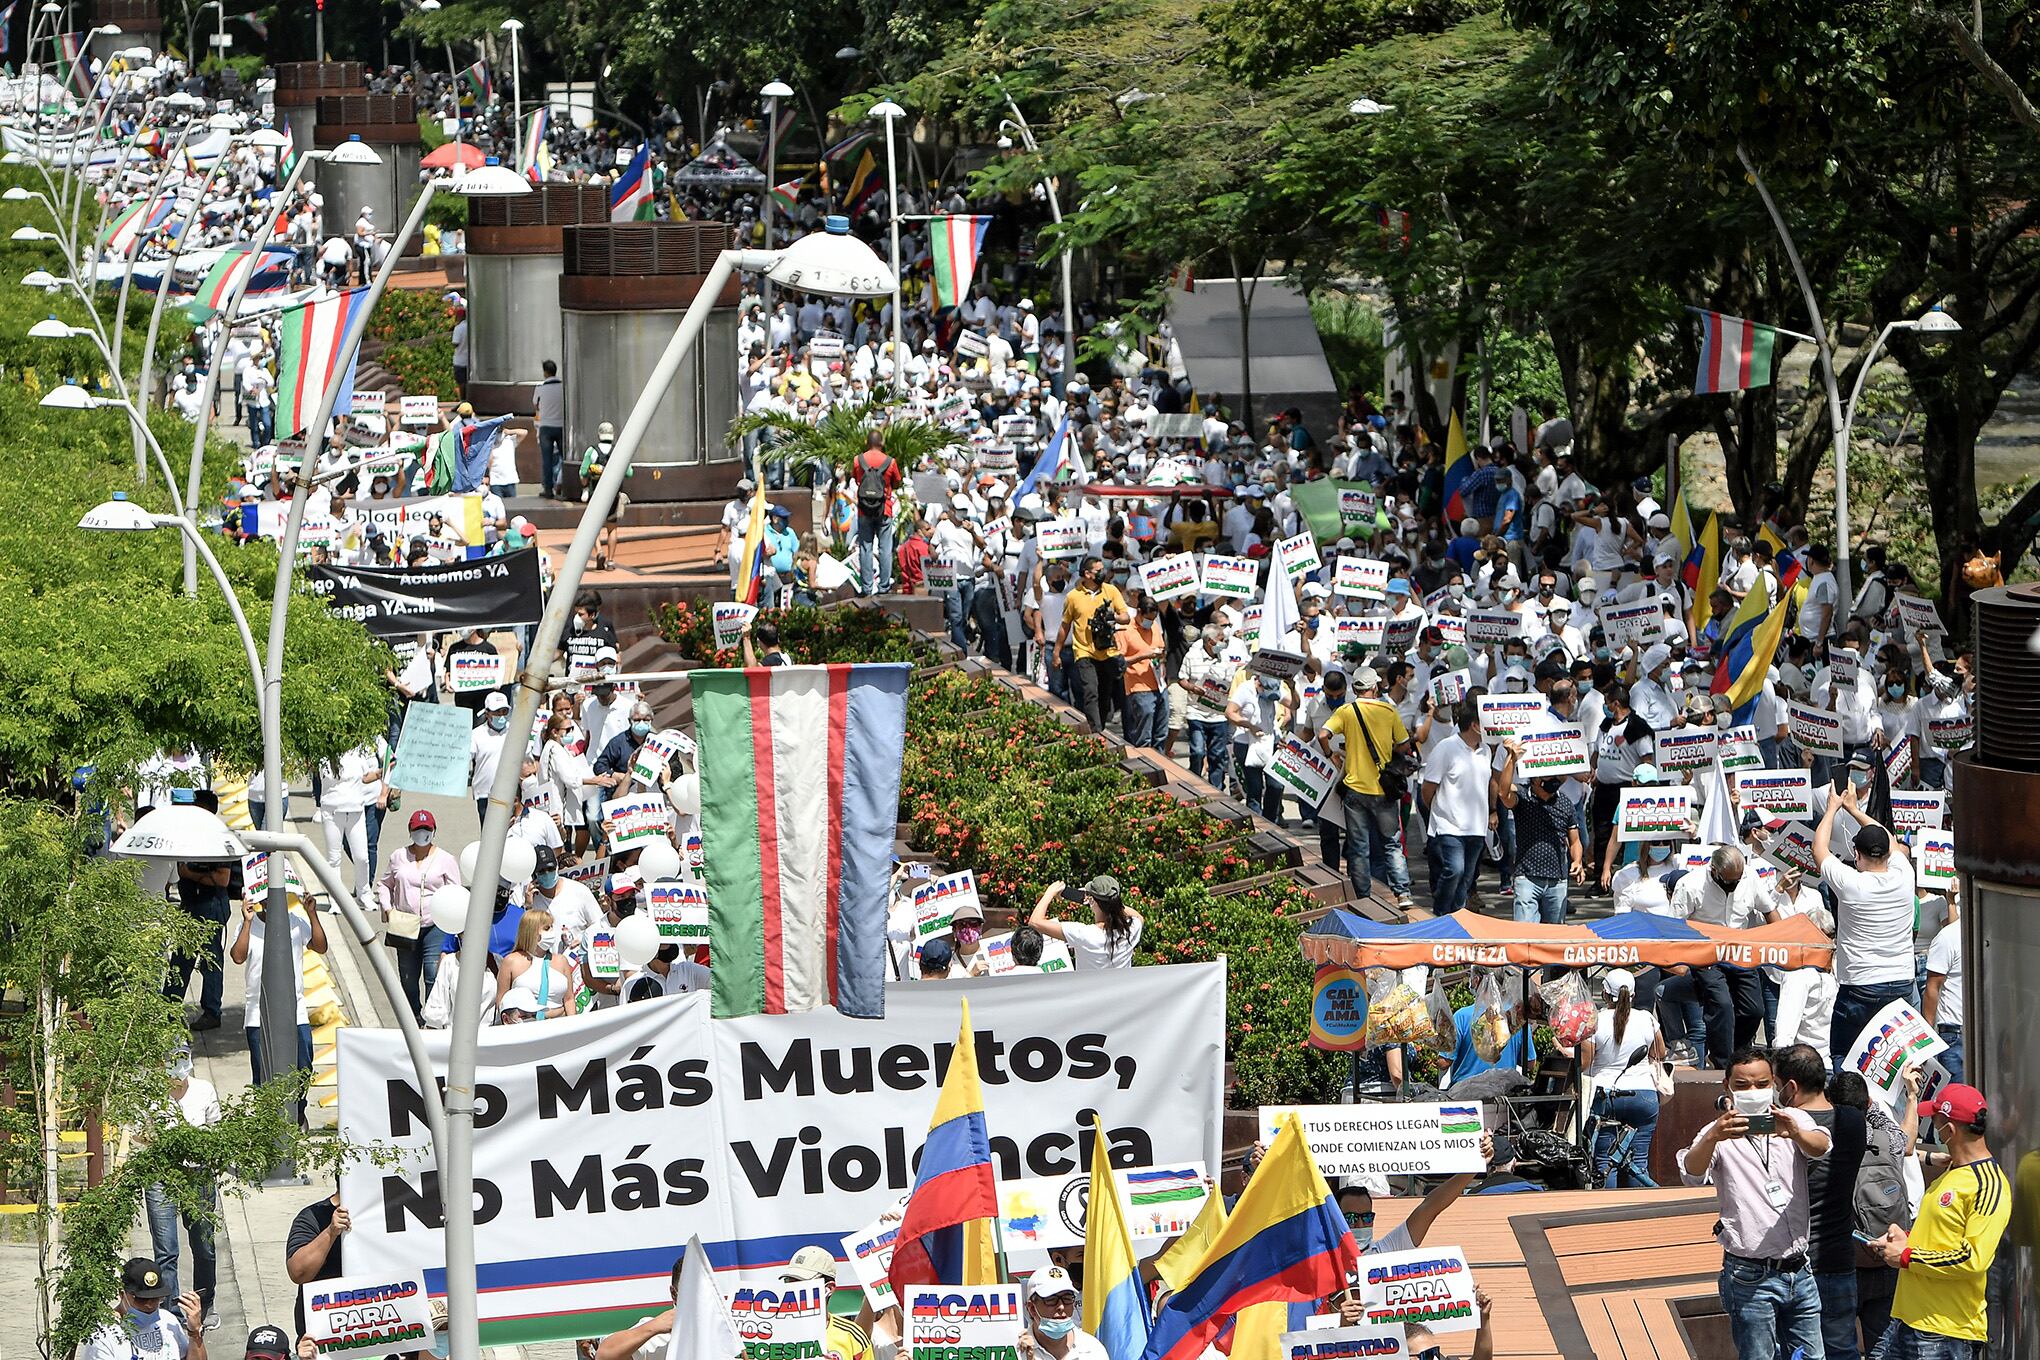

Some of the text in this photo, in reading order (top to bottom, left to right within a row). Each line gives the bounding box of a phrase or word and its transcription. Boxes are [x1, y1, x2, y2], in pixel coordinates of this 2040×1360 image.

[485, 563, 510, 578] YA
[338, 575, 362, 590] YA
[1492, 712, 1531, 725] PARA
[1796, 720, 1828, 740] PARA
[1532, 741, 1573, 757] PARA
[1670, 746, 1705, 760] PARA
[1740, 777, 1807, 789] #LIBERTAD
[1752, 789, 1794, 802] PARA
[611, 802, 665, 826] #CALI
[1626, 796, 1686, 815] #CALI
[654, 909, 682, 922] NOS
[1432, 944, 1789, 965] CERVEZA GASEOSA VIVE 100
[1331, 999, 1355, 1011] ME
[1323, 1010, 1360, 1021] AMA
[386, 1075, 508, 1138] No
[536, 1044, 714, 1120] Más
[1309, 1121, 1331, 1133] TUS
[1334, 1119, 1394, 1132] DERECHOS
[1396, 1118, 1439, 1131] LLEGAN
[1346, 1141, 1418, 1154] COMIENZAN
[1420, 1140, 1441, 1151] LOS
[1444, 1138, 1475, 1150] MIOS
[381, 1108, 1154, 1234] No Más Violncia
[1319, 1160, 1431, 1175] NO MAS BLOQUEOS
[1367, 1258, 1463, 1285] #LIBERTAD
[311, 1280, 419, 1312] #LIBERTAD
[1385, 1278, 1452, 1306] PARA
[731, 1287, 821, 1319] #CALI
[912, 1292, 1018, 1324] #CALI
[1367, 1300, 1472, 1325] TRABAJAR
[328, 1303, 402, 1334] PARA
[314, 1323, 426, 1355] TRABAJAR
[912, 1325, 961, 1344] NOS
[1291, 1336, 1400, 1360] #LIBERTAD
